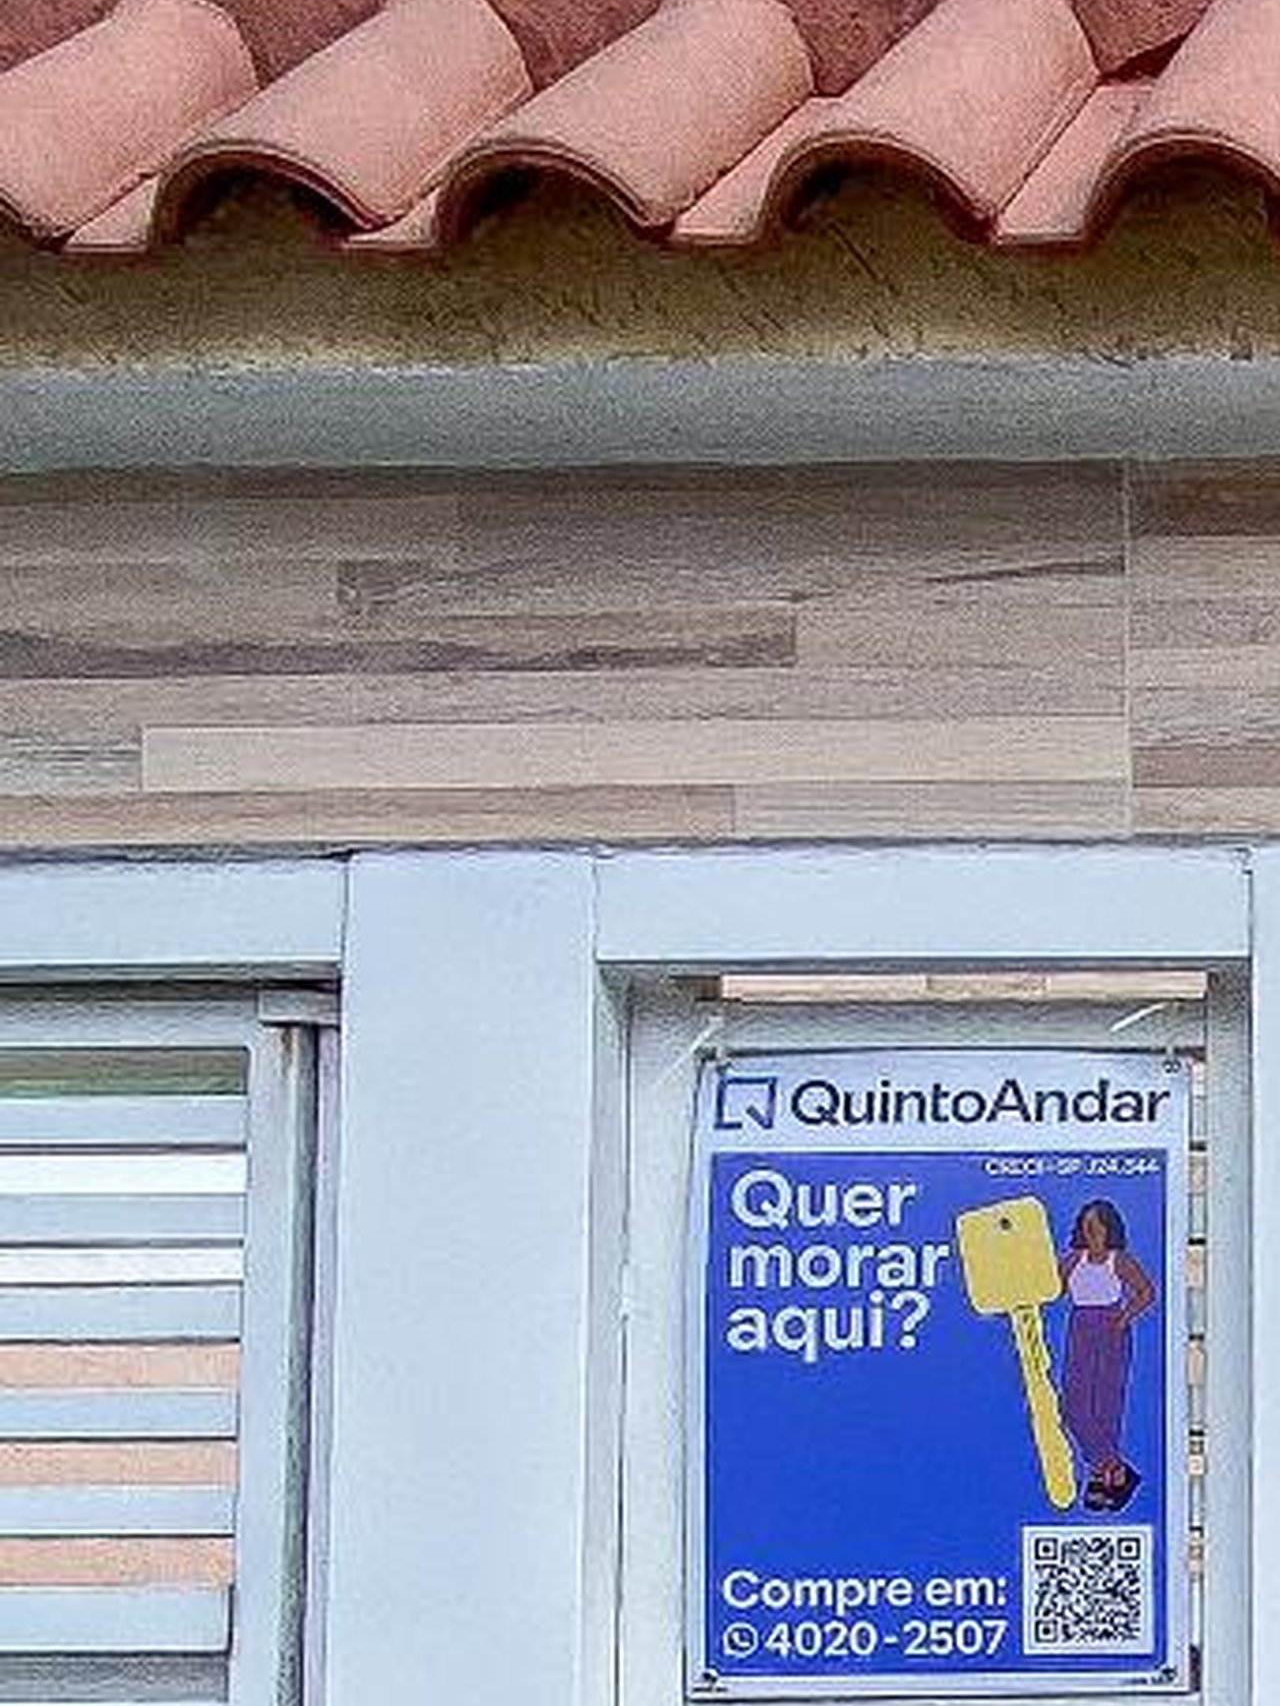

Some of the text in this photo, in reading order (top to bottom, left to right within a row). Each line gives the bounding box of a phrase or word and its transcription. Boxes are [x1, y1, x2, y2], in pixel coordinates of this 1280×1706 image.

[791, 1078, 1170, 1125] QuintoAndar
[730, 1168, 916, 1230] Quer
[728, 1241, 949, 1287] morar
[726, 1290, 930, 1362] aqui?
[722, 1570, 1007, 1616] Compre em:
[765, 1620, 1008, 1657] 4020-2507
